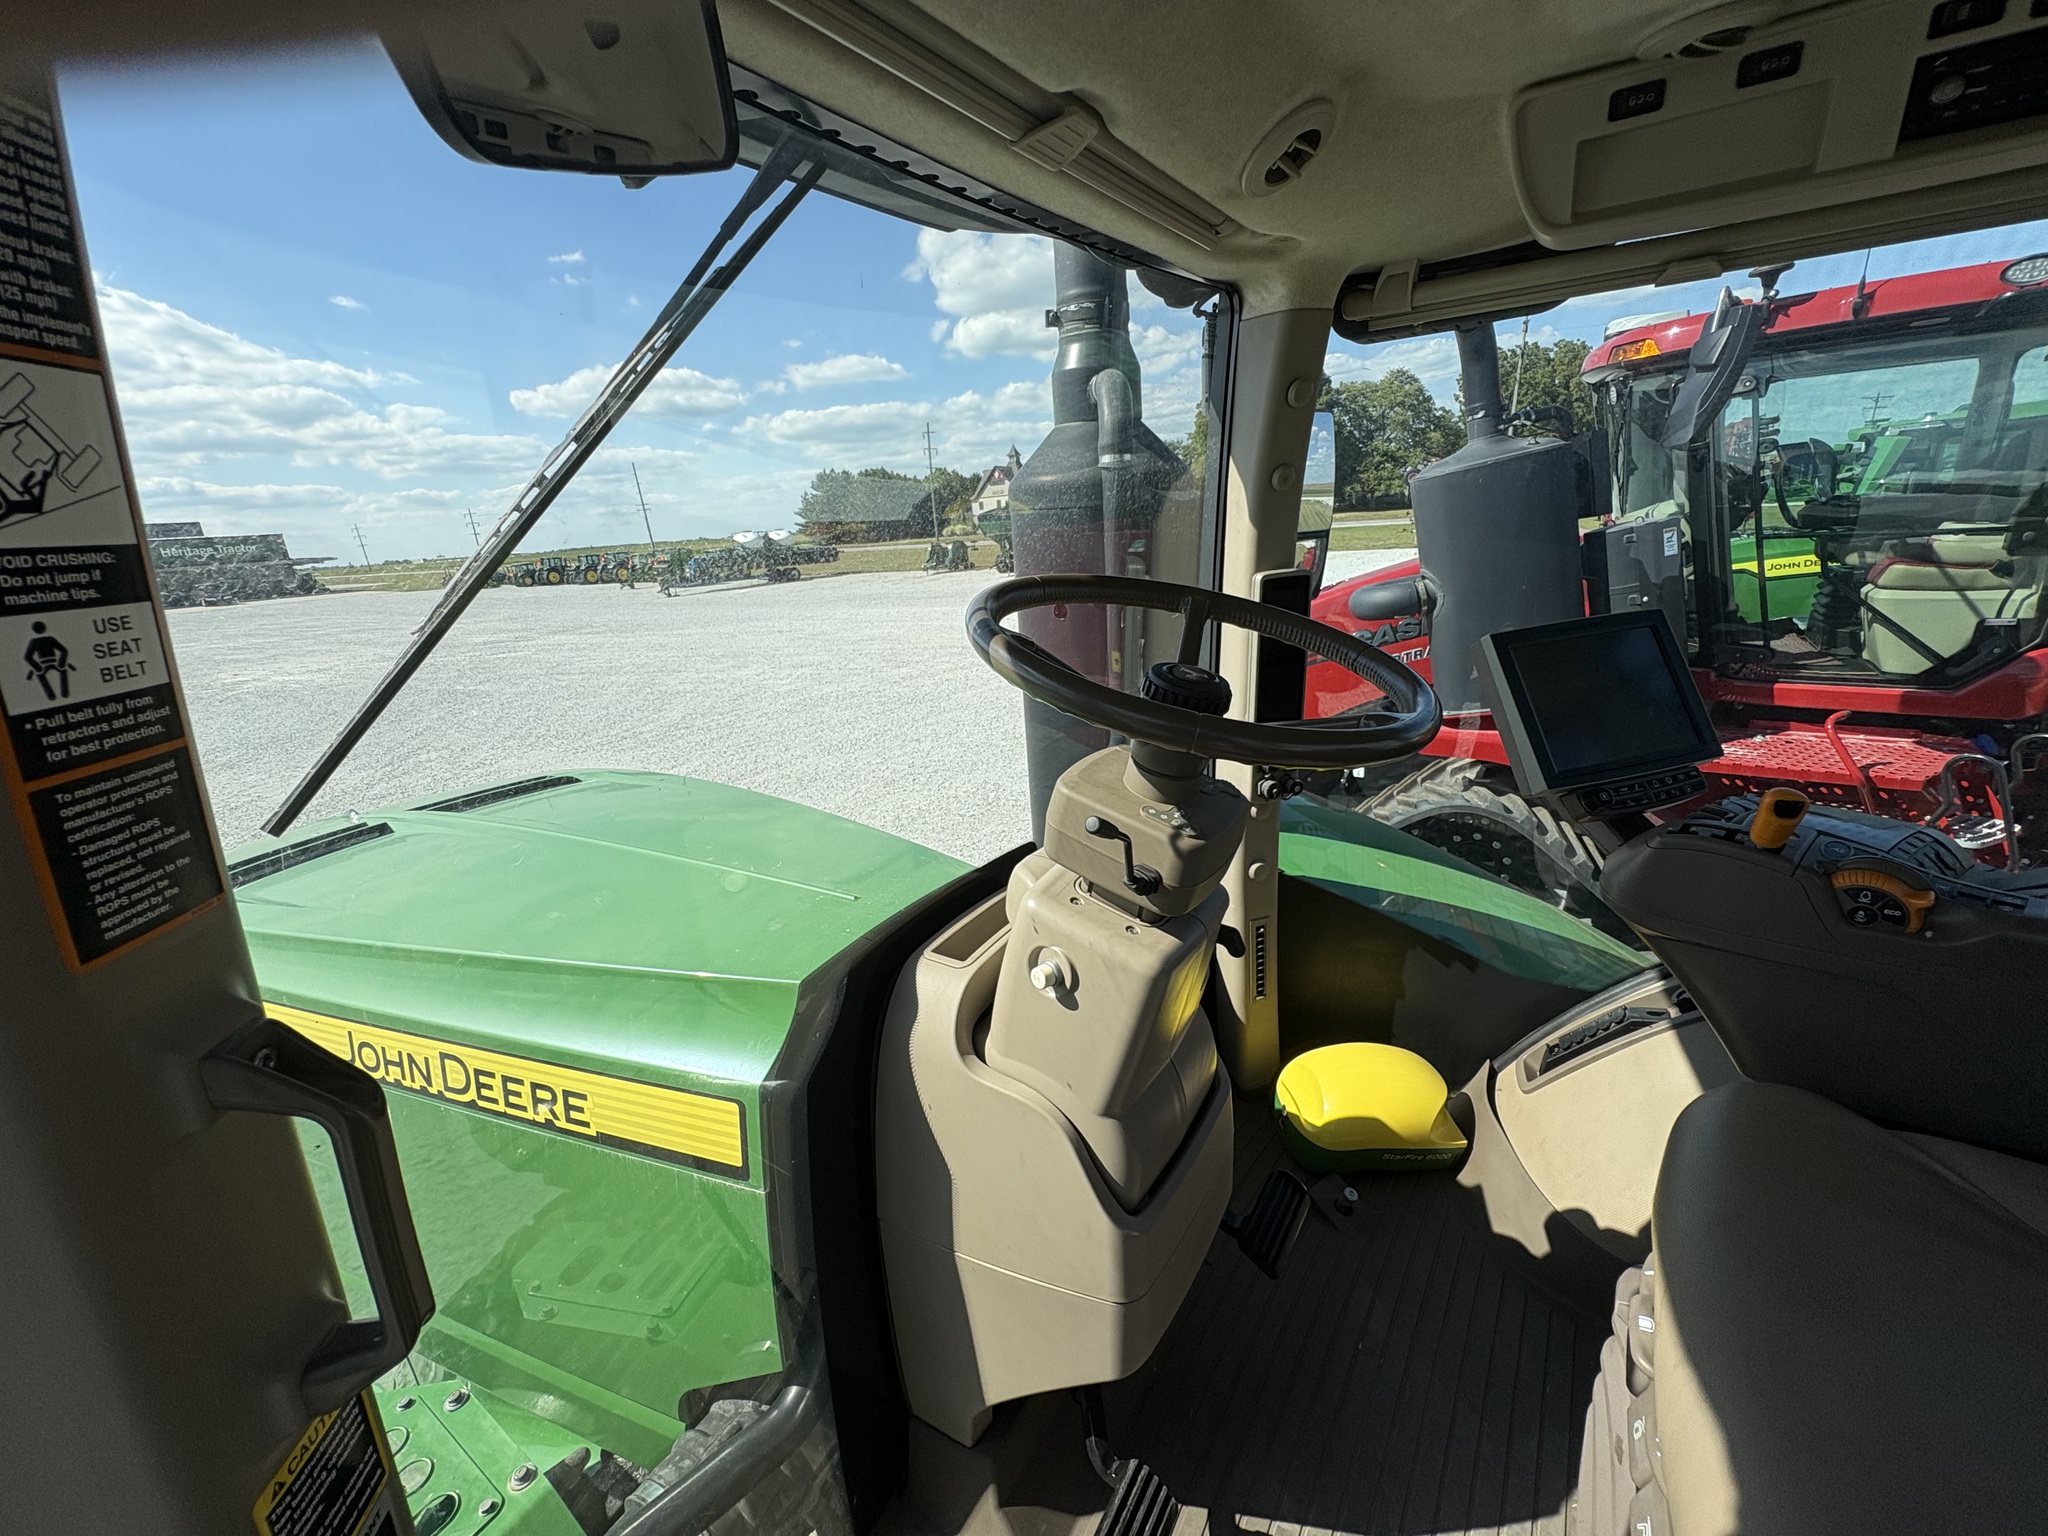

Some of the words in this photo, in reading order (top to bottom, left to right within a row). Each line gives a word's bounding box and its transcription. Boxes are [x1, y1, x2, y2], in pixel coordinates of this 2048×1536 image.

[24, 292, 58, 311] mph)
[29, 275, 74, 298] brakes:
[43, 331, 80, 348] speed.
[0, 555, 33, 569] OID
[35, 551, 116, 567] CRUSHING:
[159, 544, 214, 558] Heritage
[215, 543, 258, 554] Tractor
[1767, 562, 1801, 571] JOHN
[0, 574, 23, 587] Do
[25, 573, 53, 585] not
[53, 571, 90, 586] jump
[91, 569, 101, 581] if
[4, 590, 69, 605] machine
[70, 587, 101, 601] tips.
[93, 615, 133, 634] USE
[92, 637, 142, 660] SEAT
[100, 660, 147, 684] BELT
[34, 713, 66, 730] Pull
[66, 707, 95, 722] belt
[95, 702, 123, 716] fully
[125, 695, 153, 709] from
[41, 722, 110, 746] retractors
[111, 713, 135, 729] and
[136, 705, 171, 722] adjust
[45, 749, 68, 762] for
[69, 739, 101, 756] best
[102, 724, 166, 750] protection.
[54, 793, 72, 803] To
[73, 778, 122, 798] maintain
[122, 758, 176, 783] unimpaired
[59, 795, 108, 817] operator
[109, 778, 161, 803] protection
[161, 770, 179, 783] and
[63, 797, 144, 830] manufacturer's
[144, 784, 173, 802] ROPS
[67, 813, 136, 843] certification:
[78, 829, 131, 855] Damaged
[131, 817, 161, 835] ROPS
[81, 841, 138, 868] structures
[138, 829, 163, 846] must
[163, 825, 175, 835] be
[85, 854, 136, 880] replaced,
[136, 846, 154, 859] not
[154, 829, 191, 852] repaired
[89, 881, 102, 892] or
[103, 863, 146, 886] revised.
[94, 889, 116, 904] Any
[118, 868, 165, 894] alteration
[164, 863, 175, 873] to
[175, 856, 191, 867] the
[96, 895, 129, 917] ROPS
[130, 883, 156, 901] must
[156, 878, 169, 889] be
[100, 899, 150, 928] approved
[150, 894, 163, 905] by
[163, 886, 179, 898] the
[1883, 908, 1902, 916] ECO
[104, 903, 173, 940] manufacturer.
[344, 1030, 433, 1089] JOHN
[439, 1051, 592, 1130] DEERE
[1426, 1152, 1452, 1160] 6000
[269, 1494, 291, 1521] This
[291, 1418, 341, 1493] instructional
[273, 1509, 292, 1533] has
[291, 1478, 312, 1508] been
[313, 1427, 345, 1478] provided
[344, 1405, 359, 1428] only
[293, 1470, 327, 1519] training
[327, 1414, 362, 1469] operators
[293, 1468, 336, 1535] diagnosing
[336, 1423, 365, 1468] machine
